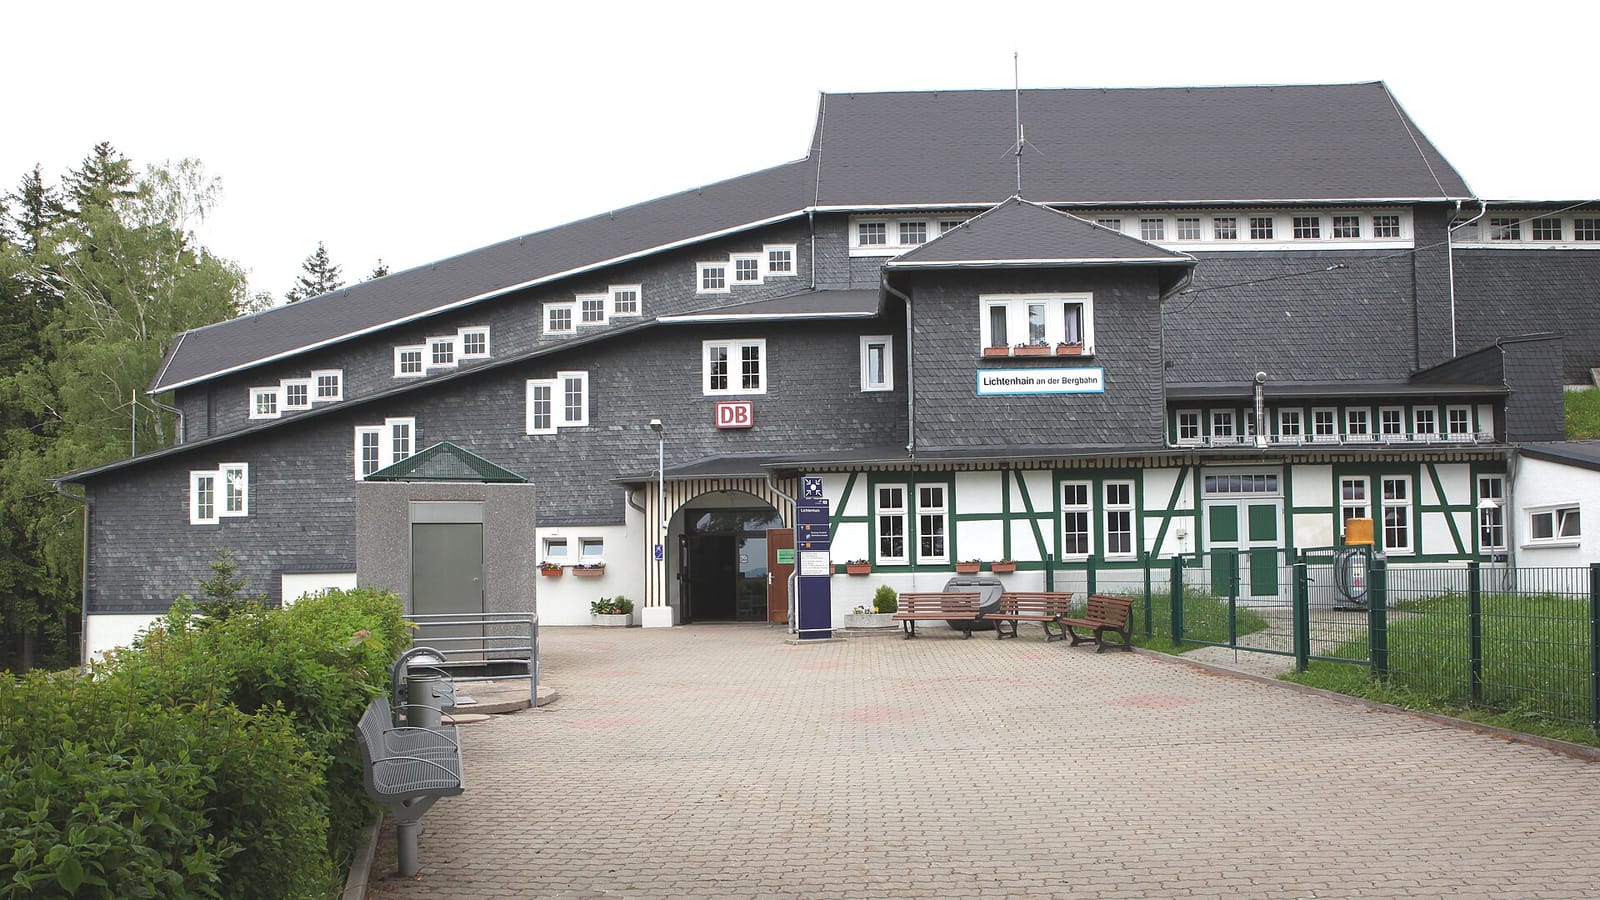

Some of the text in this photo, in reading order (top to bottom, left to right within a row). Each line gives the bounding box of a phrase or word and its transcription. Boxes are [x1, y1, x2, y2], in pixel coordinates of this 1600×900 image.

[983, 376, 1035, 386] Lichtenhain
[1047, 377, 1060, 385] der
[1061, 376, 1098, 386] Bergbahn
[721, 405, 748, 424] DB
